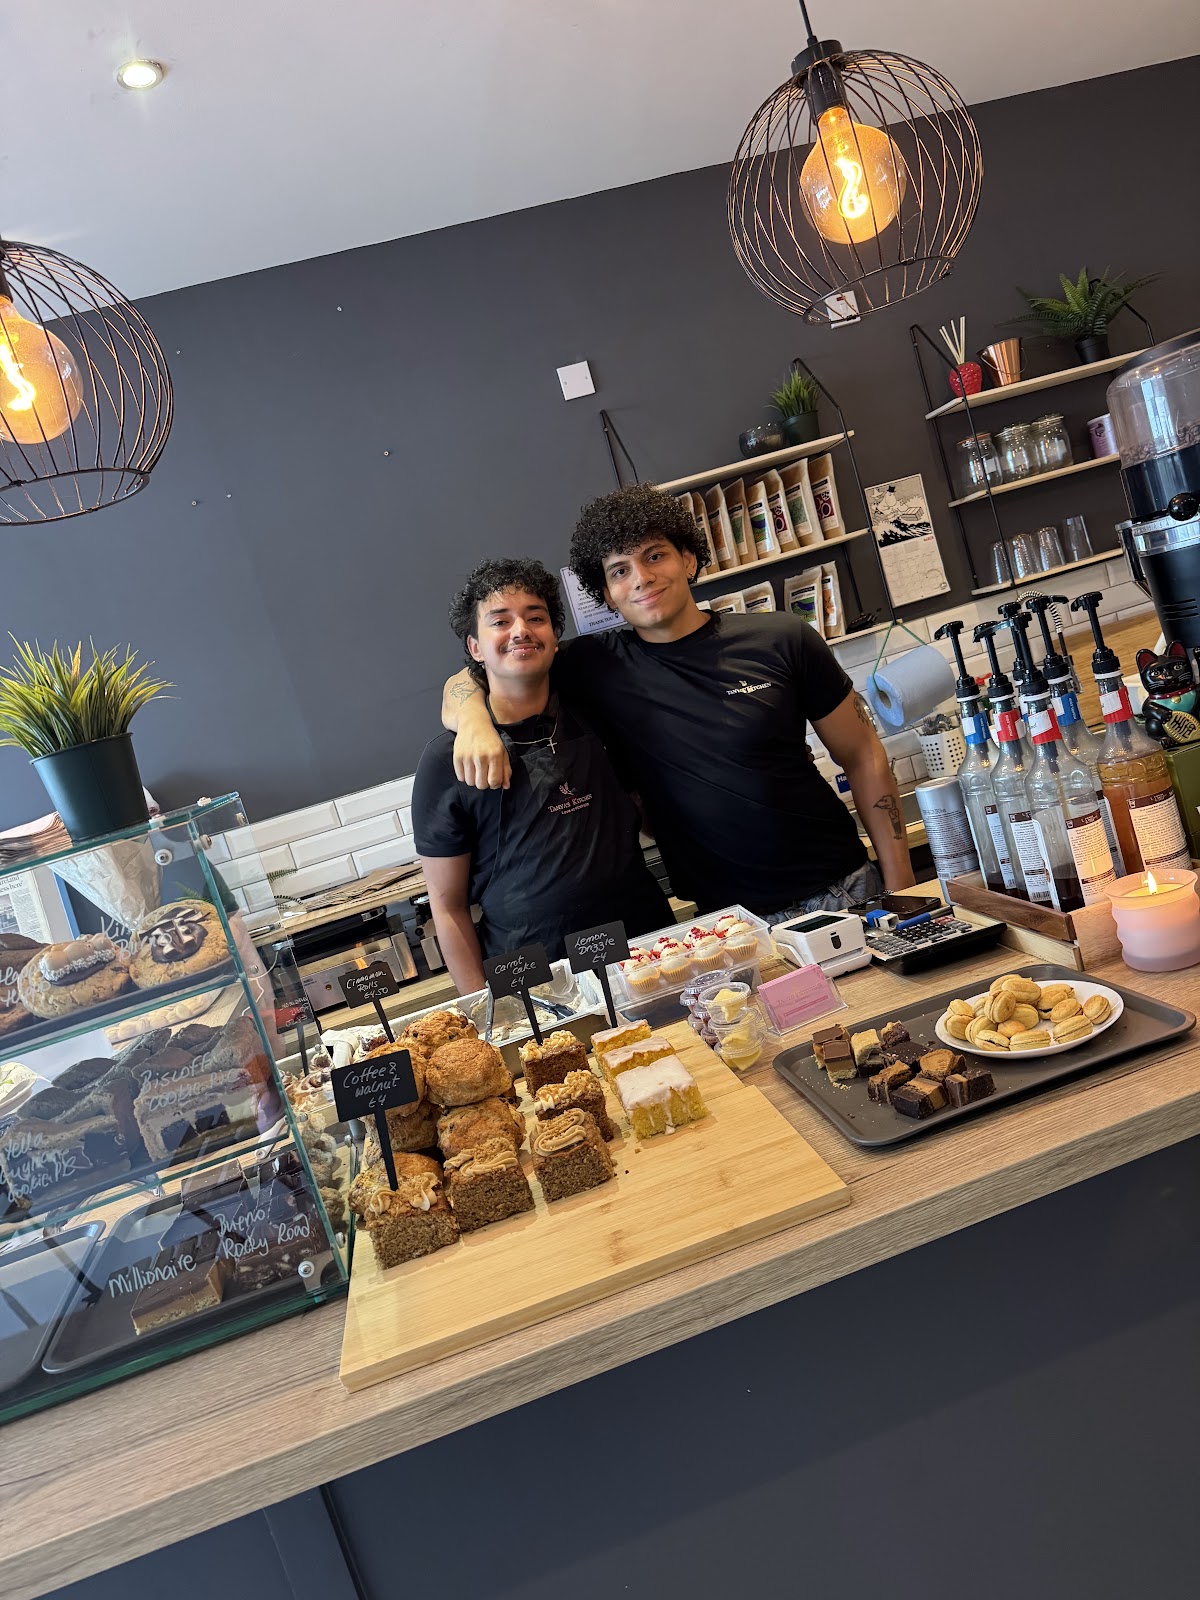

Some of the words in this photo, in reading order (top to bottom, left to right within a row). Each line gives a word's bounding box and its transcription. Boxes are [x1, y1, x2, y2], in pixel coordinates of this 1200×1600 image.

[574, 932, 608, 949] Lemon
[346, 970, 387, 990] Cinnamon
[356, 980, 379, 992] Rolls
[343, 1065, 387, 1089] Coffee
[213, 1208, 266, 1237] Bueno
[222, 1229, 269, 1260] Rocky
[277, 1213, 310, 1244] Road
[108, 1253, 197, 1299] Millionaire
